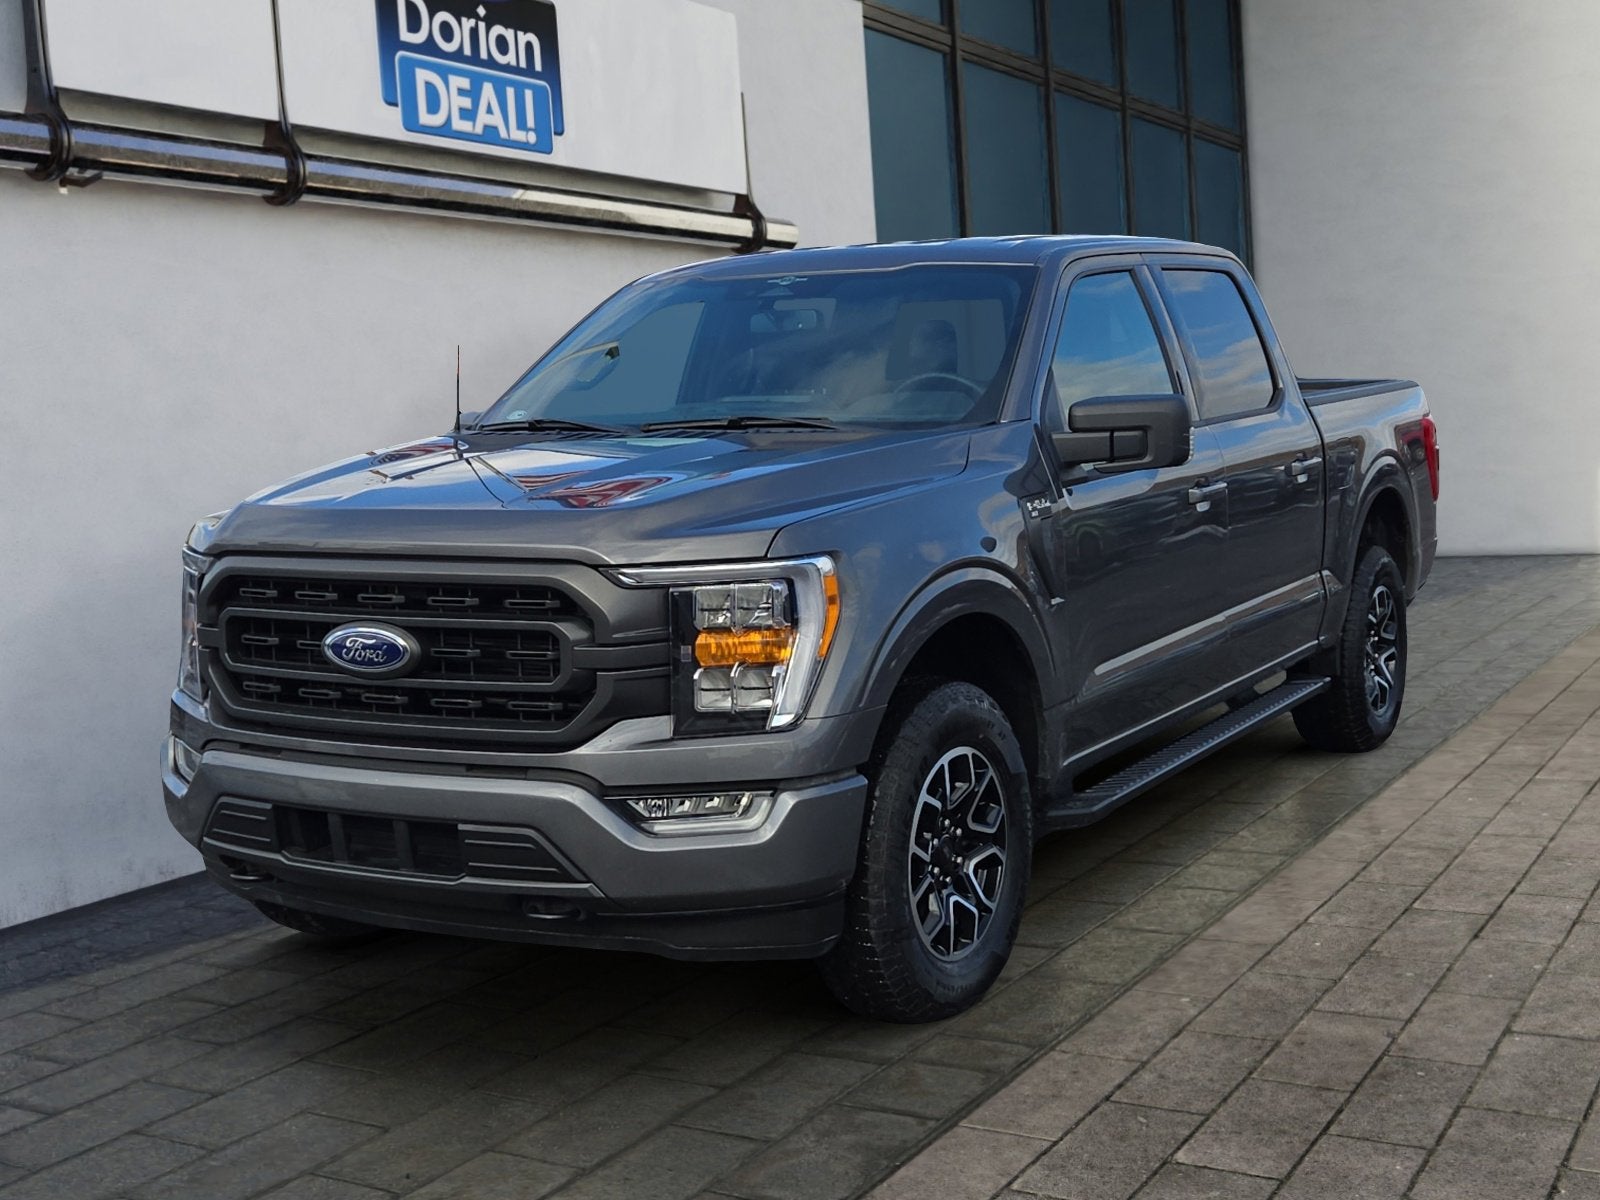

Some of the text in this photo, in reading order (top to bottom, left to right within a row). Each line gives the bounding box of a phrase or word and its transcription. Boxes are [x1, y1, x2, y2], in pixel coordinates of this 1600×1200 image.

[397, 0, 542, 72] Dorian
[415, 67, 537, 145] DEAL!
[341, 637, 388, 662] Ford
